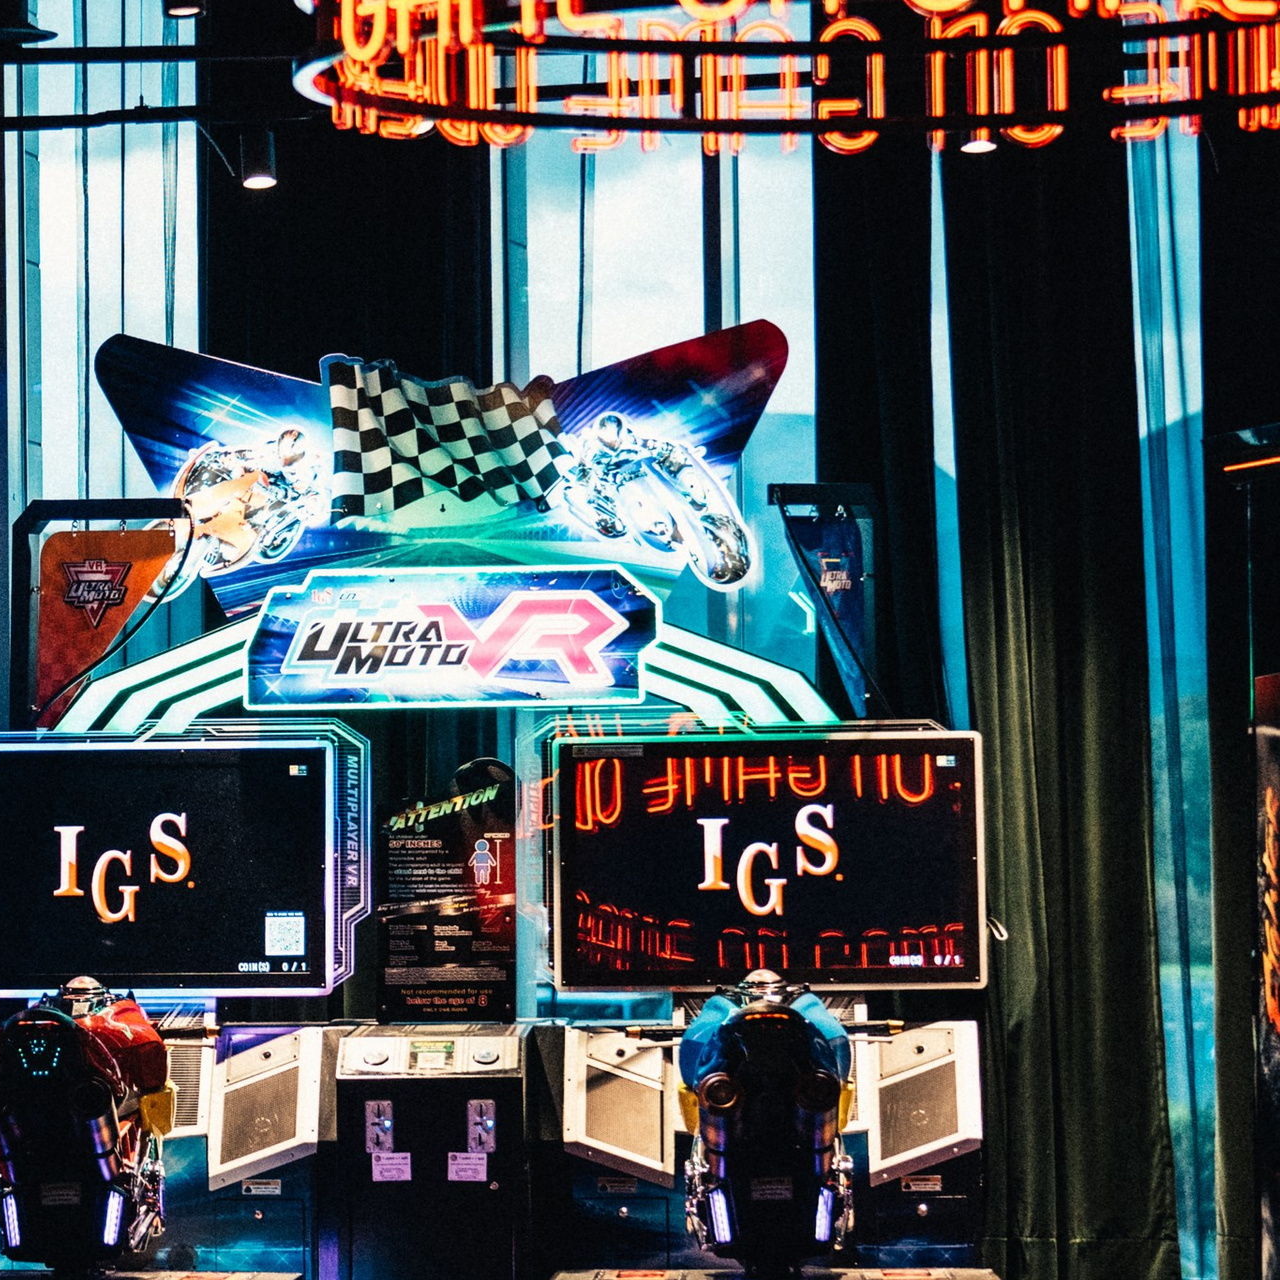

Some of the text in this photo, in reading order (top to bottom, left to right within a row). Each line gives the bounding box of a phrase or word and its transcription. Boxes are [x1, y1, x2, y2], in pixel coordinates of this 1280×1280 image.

[68, 581, 113, 598] ULTRA
[79, 590, 120, 602] MOTO
[297, 620, 443, 661] ULTRA
[417, 598, 617, 678] VR
[335, 642, 470, 675] MOTO
[346, 755, 359, 888] MULTIPLAYER VR
[390, 783, 500, 832] ATTENTION
[406, 840, 442, 848] INCHES
[697, 803, 840, 916] IGS
[53, 812, 191, 923] IGS
[238, 961, 270, 973] COIN(S)
[432, 996, 447, 1004] the
[465, 996, 476, 1004] of
[478, 994, 488, 1007] 8
